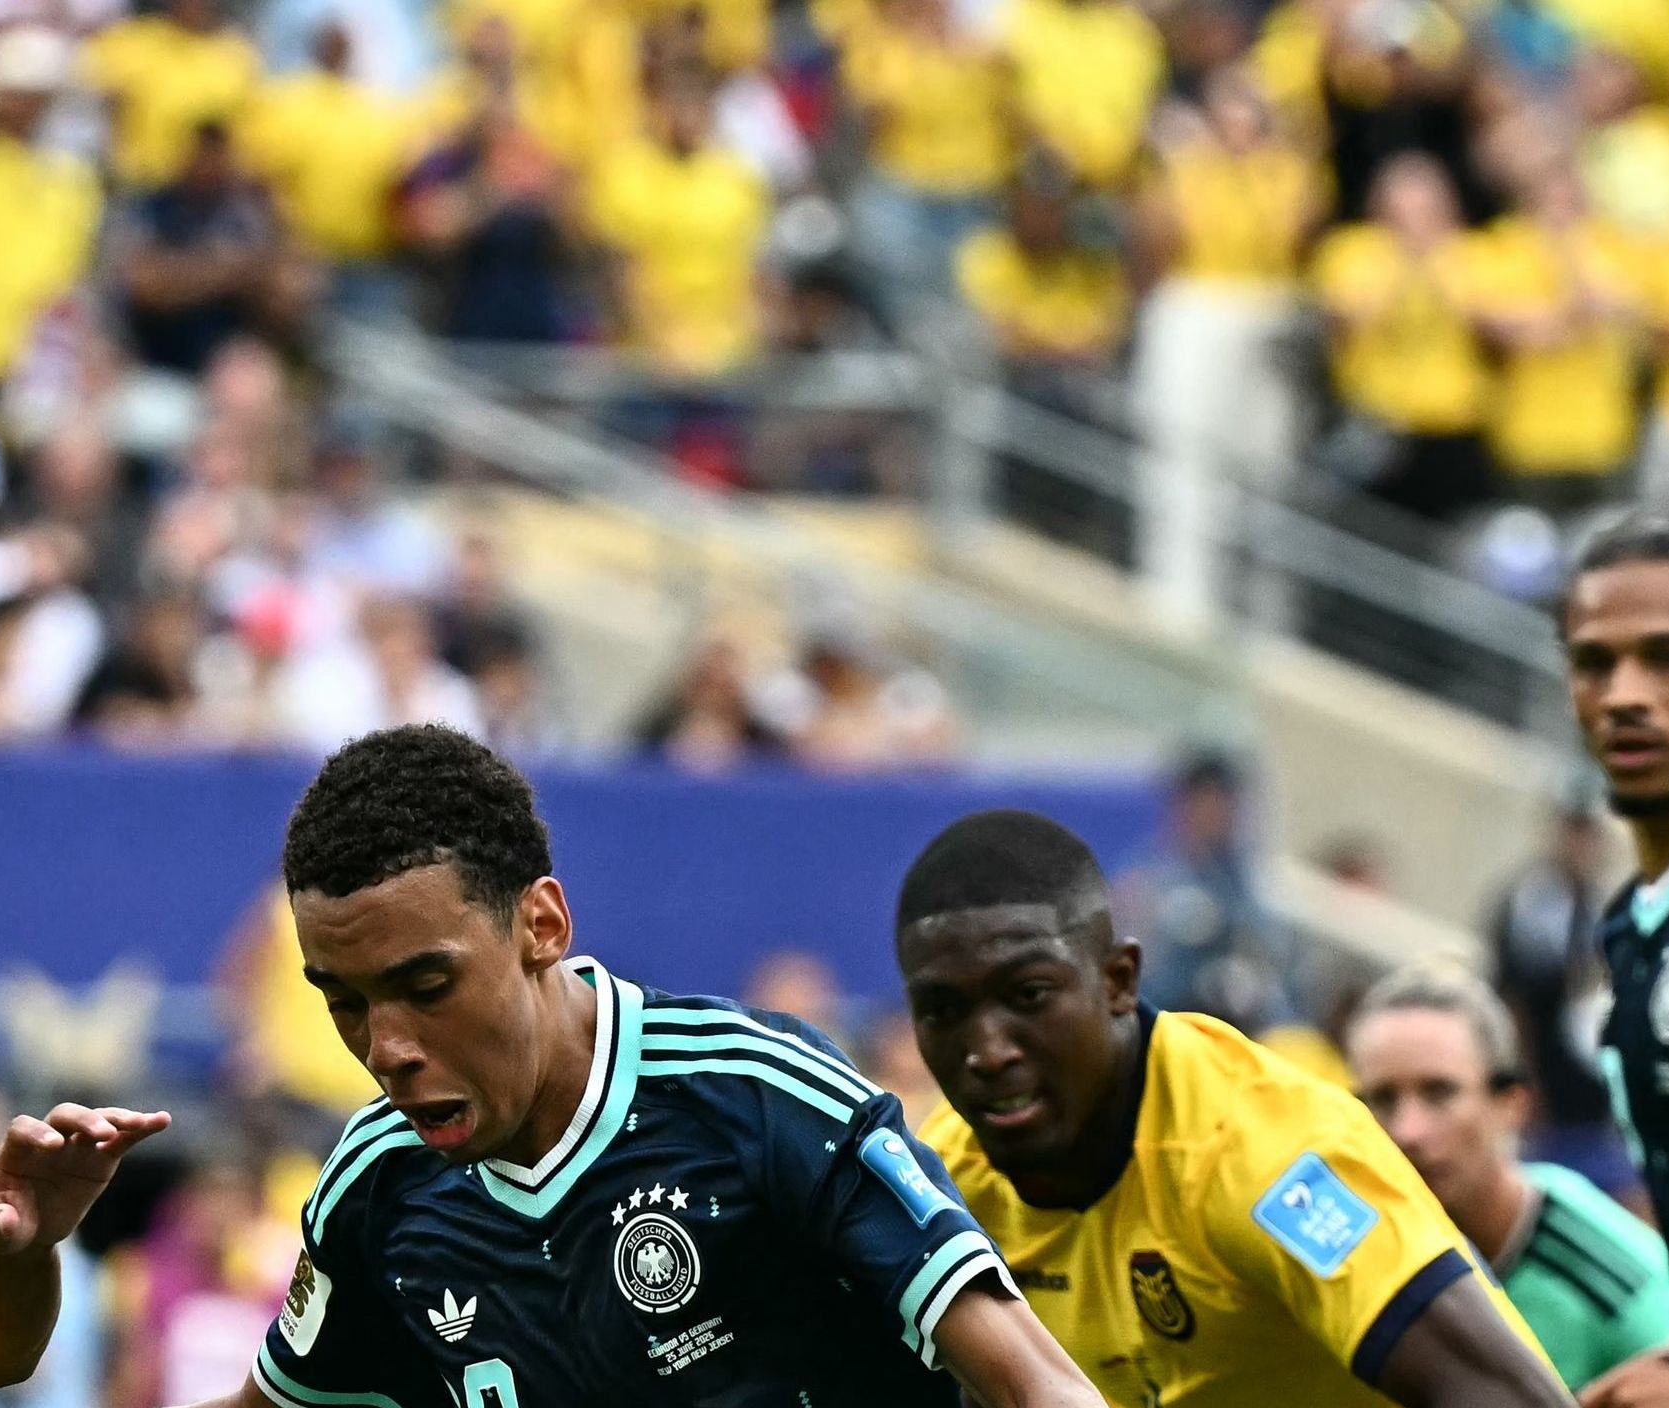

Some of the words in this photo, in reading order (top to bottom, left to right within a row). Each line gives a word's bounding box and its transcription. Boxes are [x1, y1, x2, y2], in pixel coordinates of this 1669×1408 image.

[627, 1226, 673, 1250] DEUTSCHER
[629, 1266, 688, 1301] FUSSBALL-BUND
[647, 1337, 679, 1359] ECUADOR
[679, 1331, 689, 1344] VS
[688, 1316, 723, 1338] GERMANY
[665, 1352, 677, 1363] 25
[678, 1342, 695, 1357] JUNE
[695, 1330, 715, 1347] 2026
[672, 1354, 692, 1372] YORK
[691, 1345, 707, 1361] NEW
[707, 1332, 735, 1352] JERSEY
